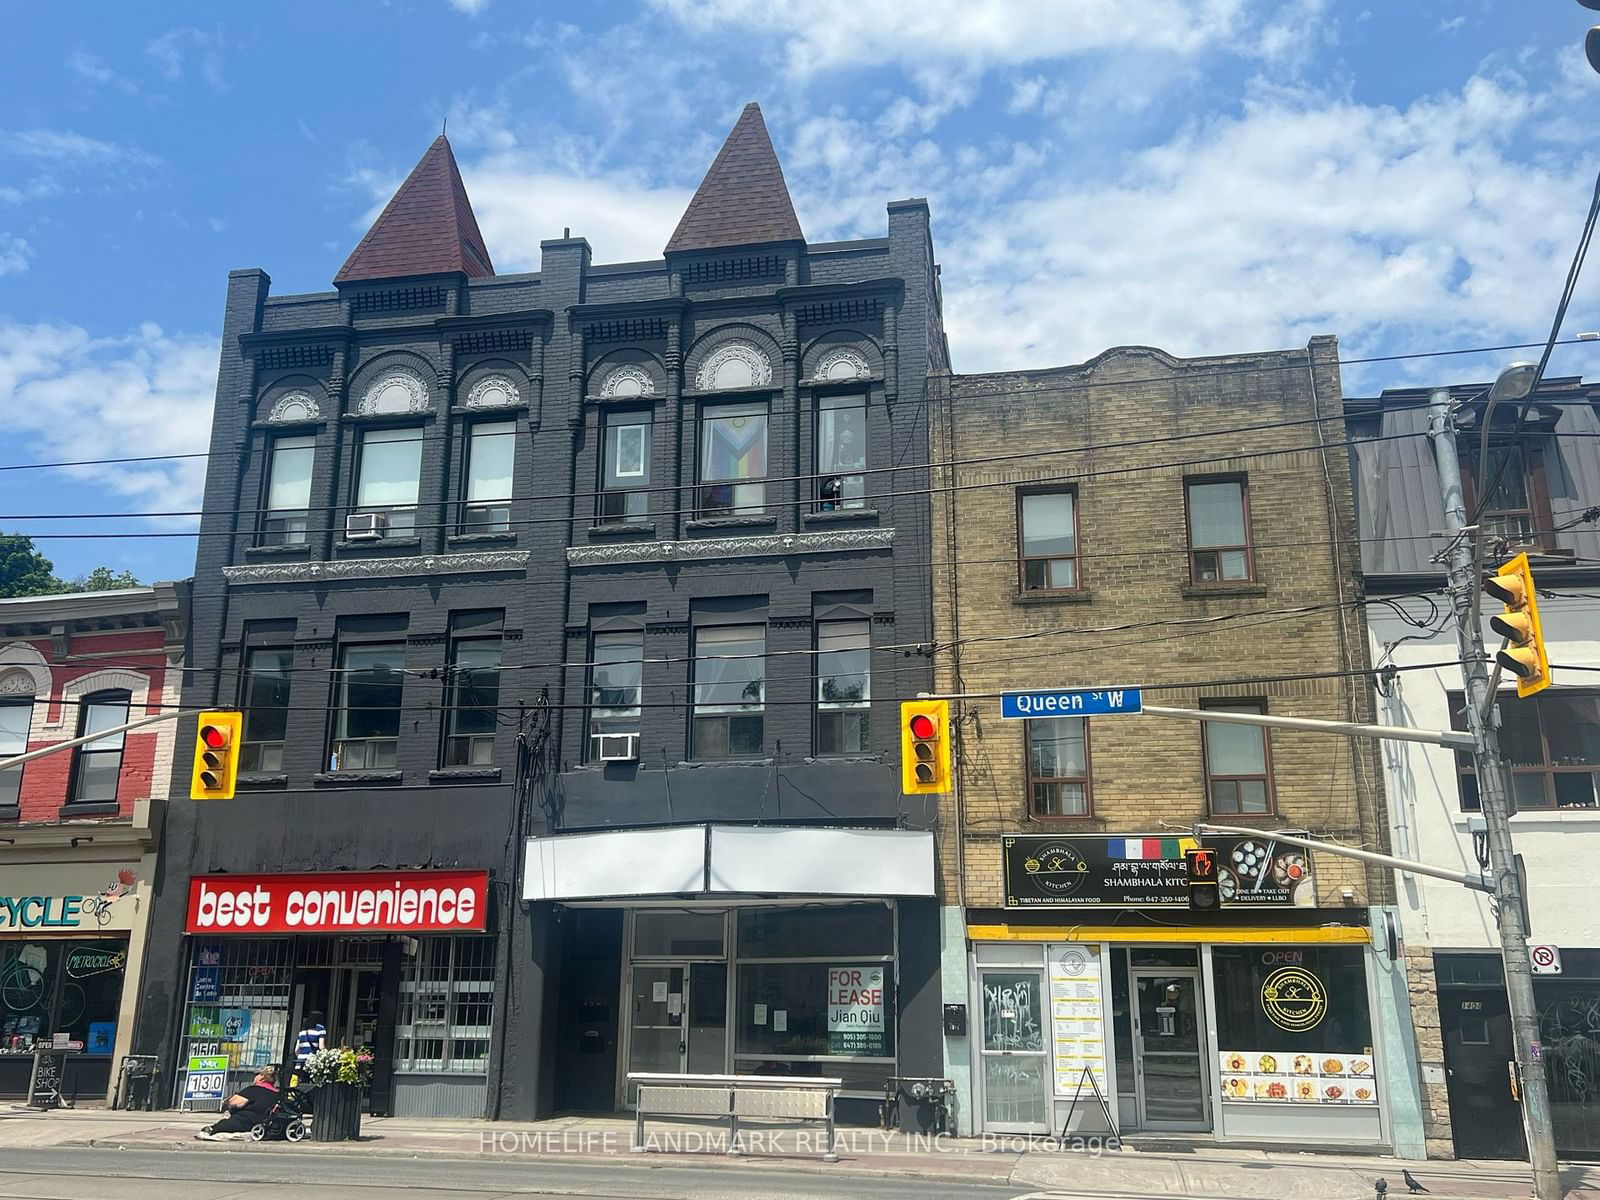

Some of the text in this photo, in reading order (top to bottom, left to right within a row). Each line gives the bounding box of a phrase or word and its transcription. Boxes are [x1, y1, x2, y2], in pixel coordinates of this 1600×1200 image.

[1016, 690, 1123, 713] Queen St W
[1039, 848, 1076, 862] SHAMBHALA
[1044, 880, 1073, 890] KITCHEN
[1103, 877, 1189, 887] SHAMBHALA KITC
[196, 880, 476, 927] best convenience
[1123, 895, 1145, 903] Phone:
[1261, 951, 1303, 965] OPEN
[829, 970, 862, 987] FOR
[829, 989, 882, 1006] LEASE
[831, 1009, 880, 1024] Jian Qiu
[37, 1067, 56, 1078] BIKE
[36, 1078, 60, 1089] SHOP
